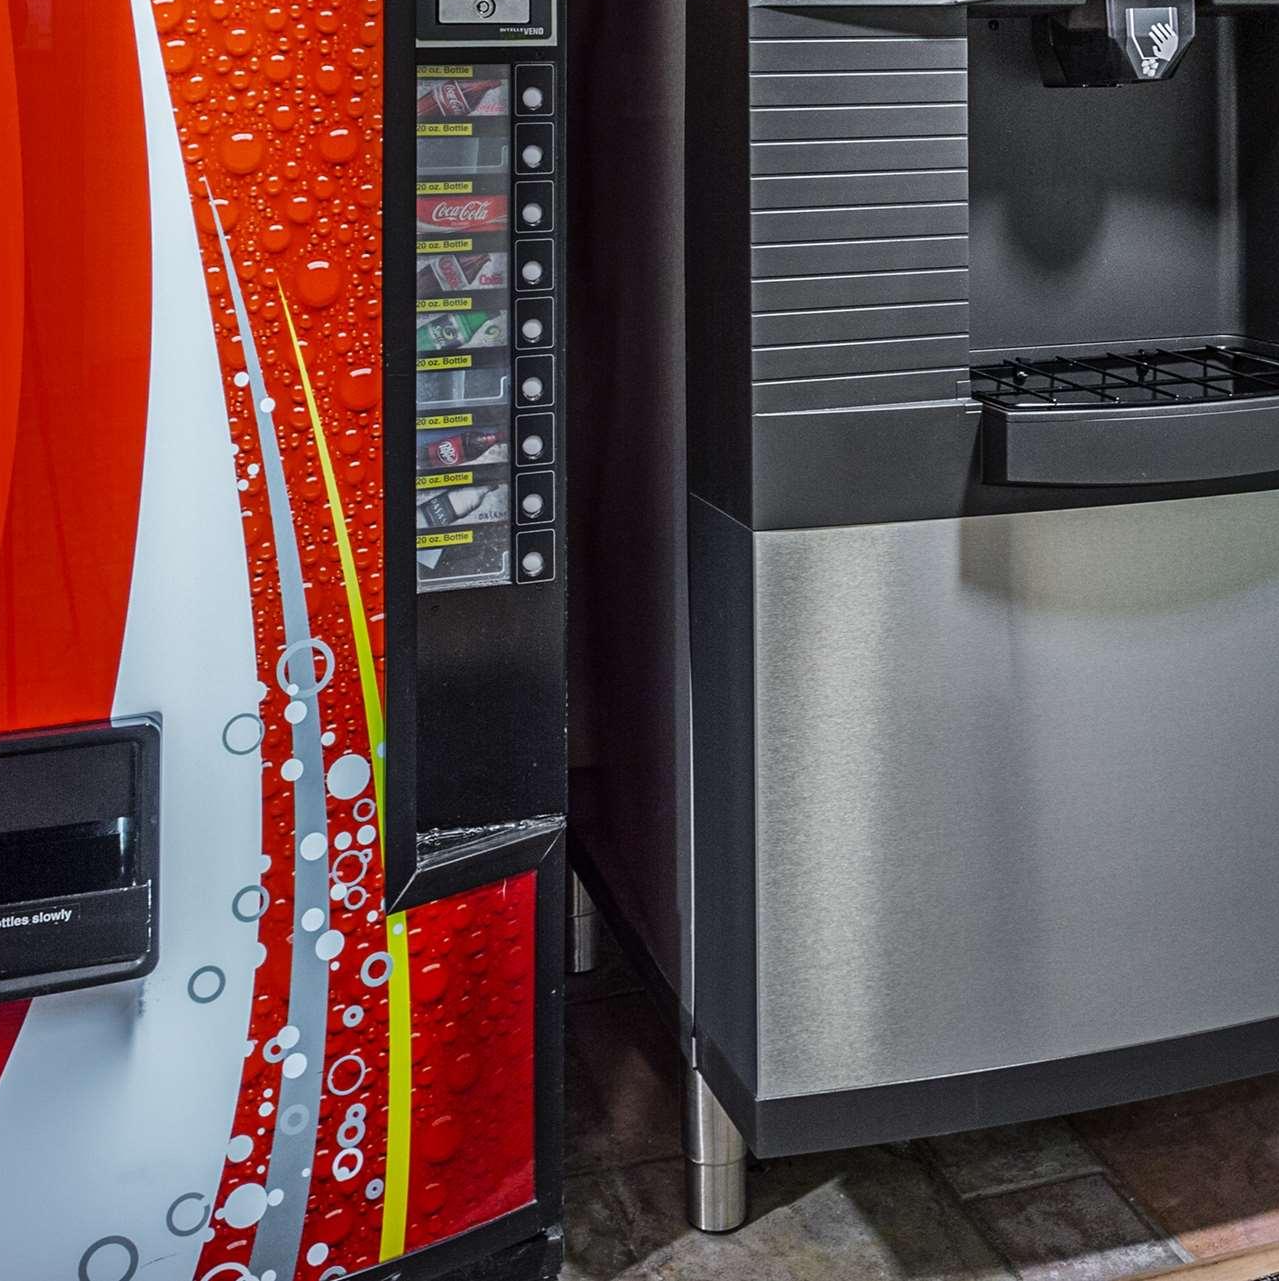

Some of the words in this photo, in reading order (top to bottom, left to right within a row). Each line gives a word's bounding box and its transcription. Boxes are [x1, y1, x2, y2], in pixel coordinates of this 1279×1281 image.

[432, 201, 490, 221] Coca-Cola
[443, 240, 469, 248] Bottle
[442, 357, 468, 365] Bottle
[443, 415, 469, 424] Bottle
[443, 474, 469, 482] Bottle
[443, 533, 469, 541] Bottle
[32, 908, 72, 926] slowly
